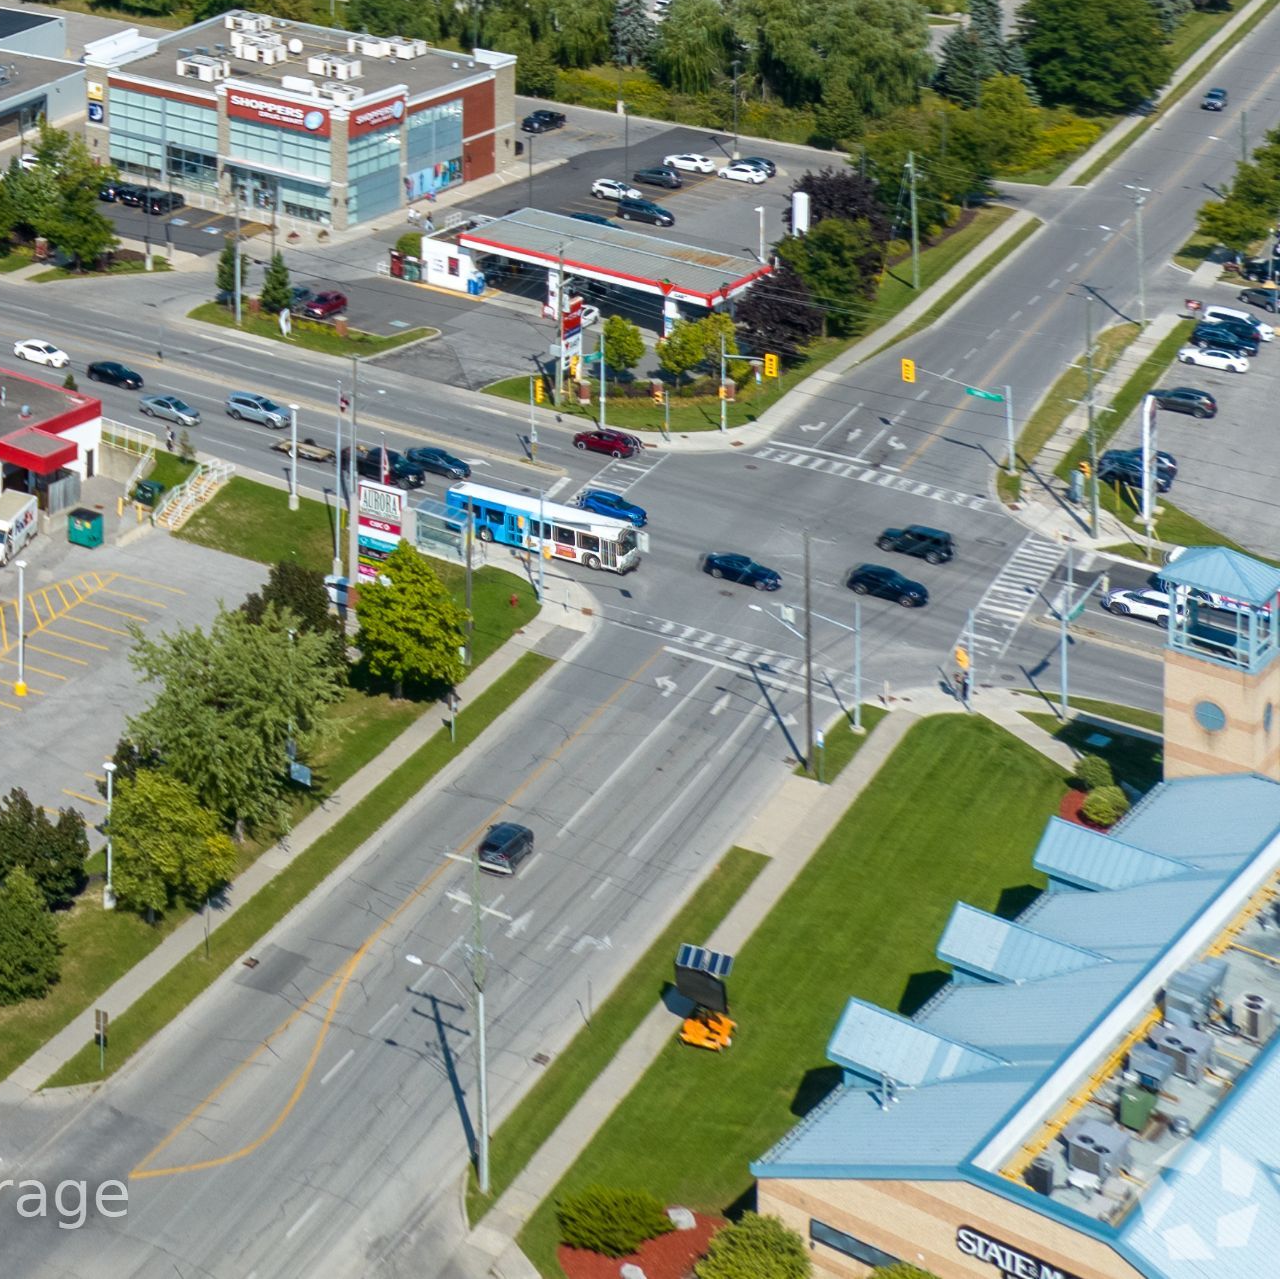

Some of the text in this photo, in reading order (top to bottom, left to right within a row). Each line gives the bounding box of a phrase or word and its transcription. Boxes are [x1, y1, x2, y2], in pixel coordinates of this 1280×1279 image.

[229, 95, 304, 119] SHOPPERS
[362, 488, 399, 515] AURORA
[957, 1228, 1037, 1279] STATE
